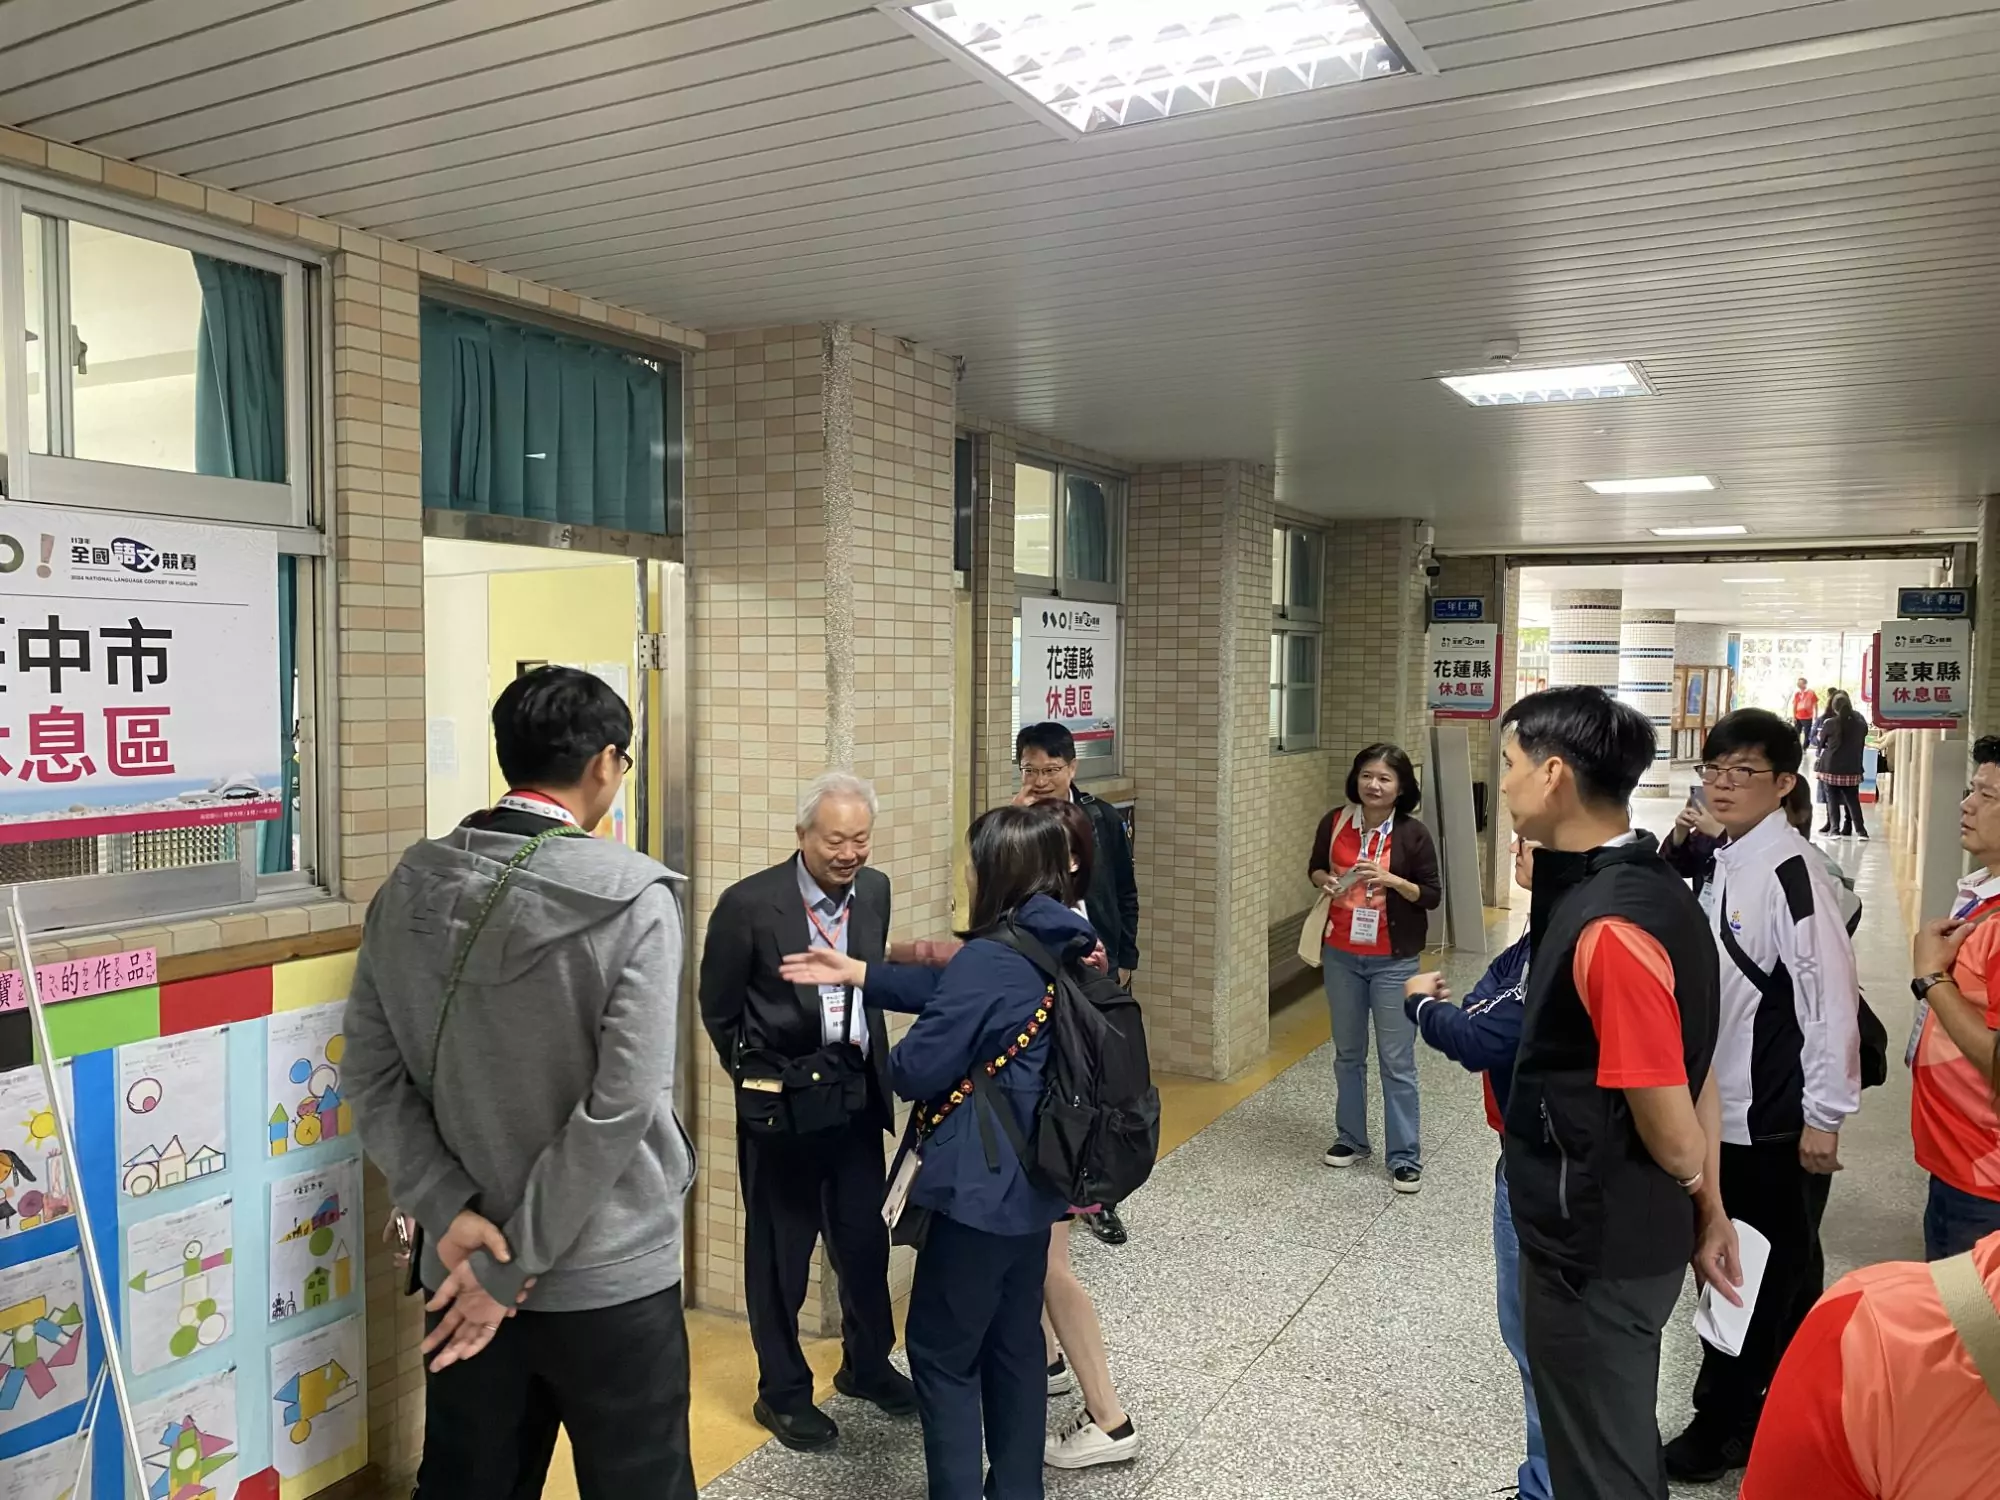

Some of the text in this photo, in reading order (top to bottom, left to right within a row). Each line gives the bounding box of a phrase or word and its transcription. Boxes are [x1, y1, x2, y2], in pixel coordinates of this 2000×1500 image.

[71, 542, 197, 571] 全國語文競賽
[0, 615, 172, 693] 中市
[1046, 645, 1094, 680] 花蓮縣
[1433, 660, 1491, 678] 花蓮縣
[1885, 661, 1960, 682] 臺東縣
[1046, 684, 1093, 719] 休息區
[1438, 682, 1485, 697] 休息區
[1892, 686, 1952, 703] 休息區
[0, 705, 176, 783] 息區
[0, 953, 144, 1008] 寶的作品
